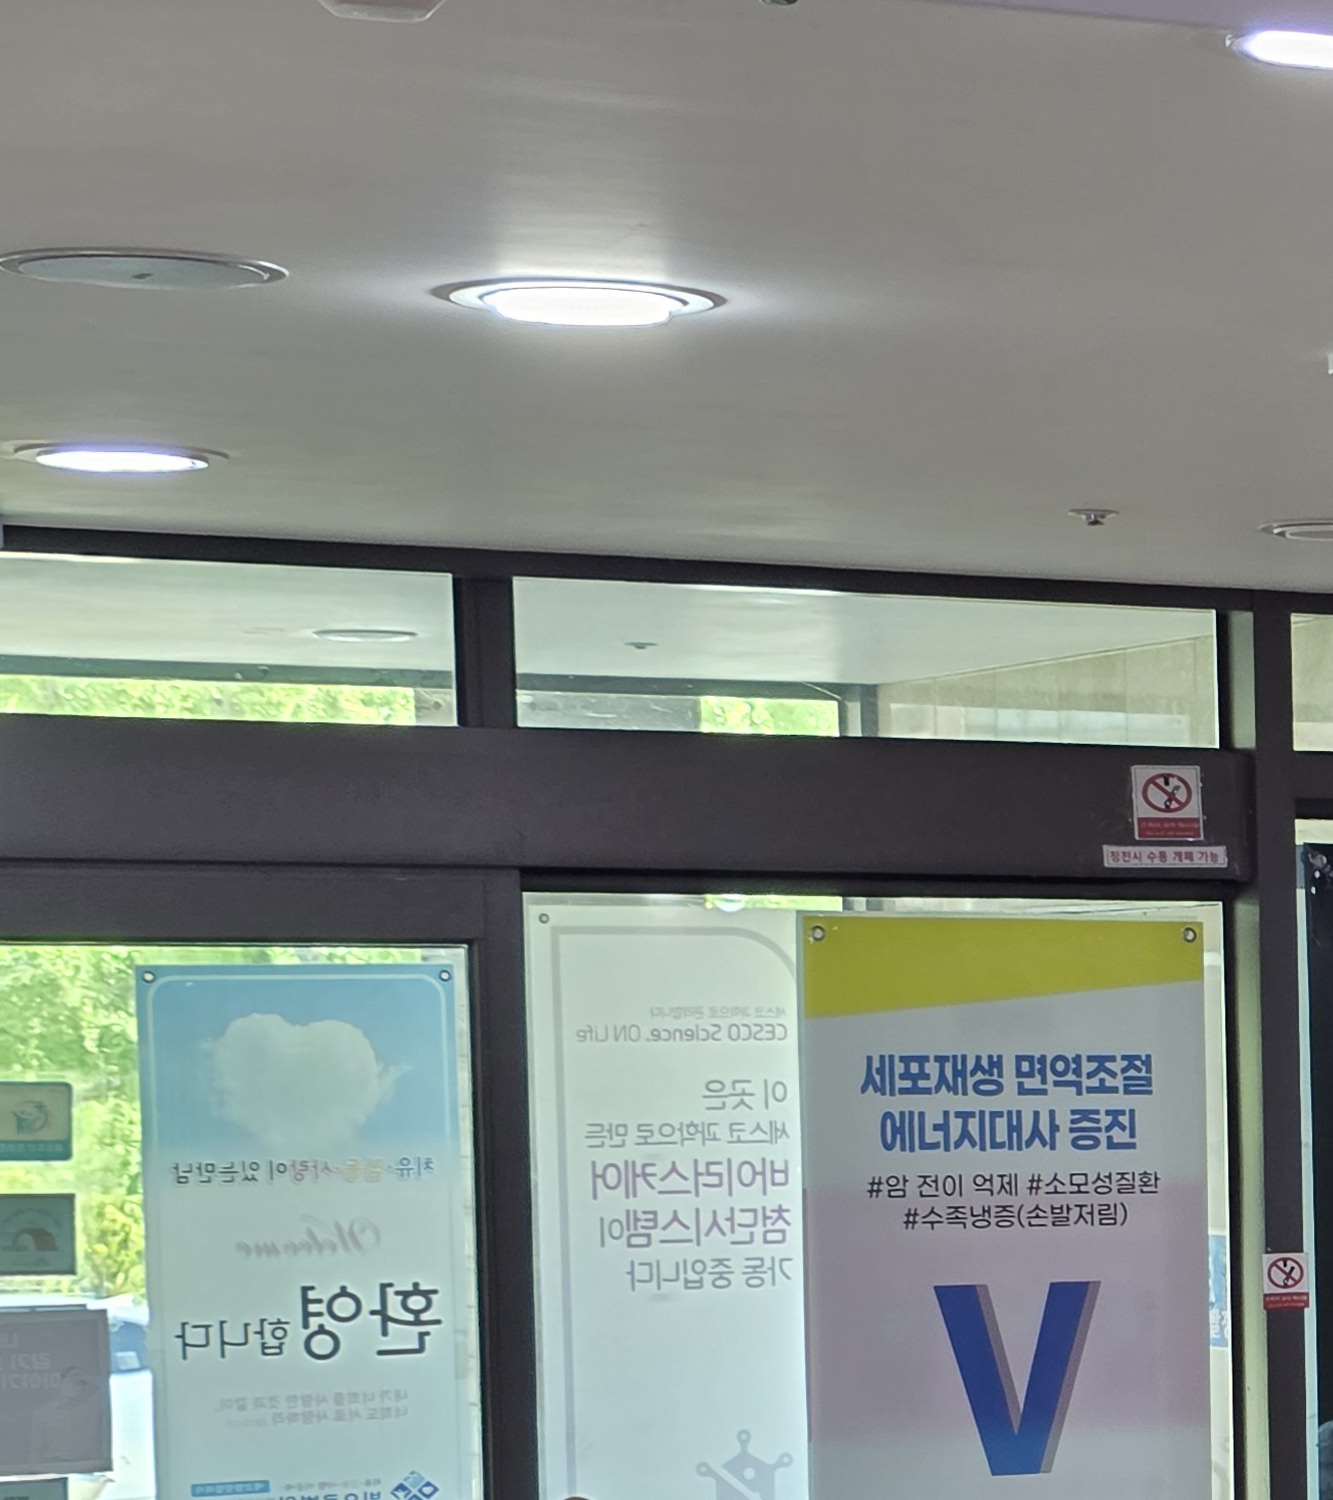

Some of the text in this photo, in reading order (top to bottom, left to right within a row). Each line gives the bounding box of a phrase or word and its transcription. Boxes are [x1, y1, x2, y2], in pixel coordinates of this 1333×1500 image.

[860, 1054, 1154, 1097] 세포재생 면역조절
[881, 1109, 1137, 1152] 에너지대사 증진
[867, 1171, 1160, 1199] #암 전이 억제 #소모성질환
[904, 1202, 1128, 1230] #수족냉증(손발저림)
[934, 1281, 1101, 1476] V
